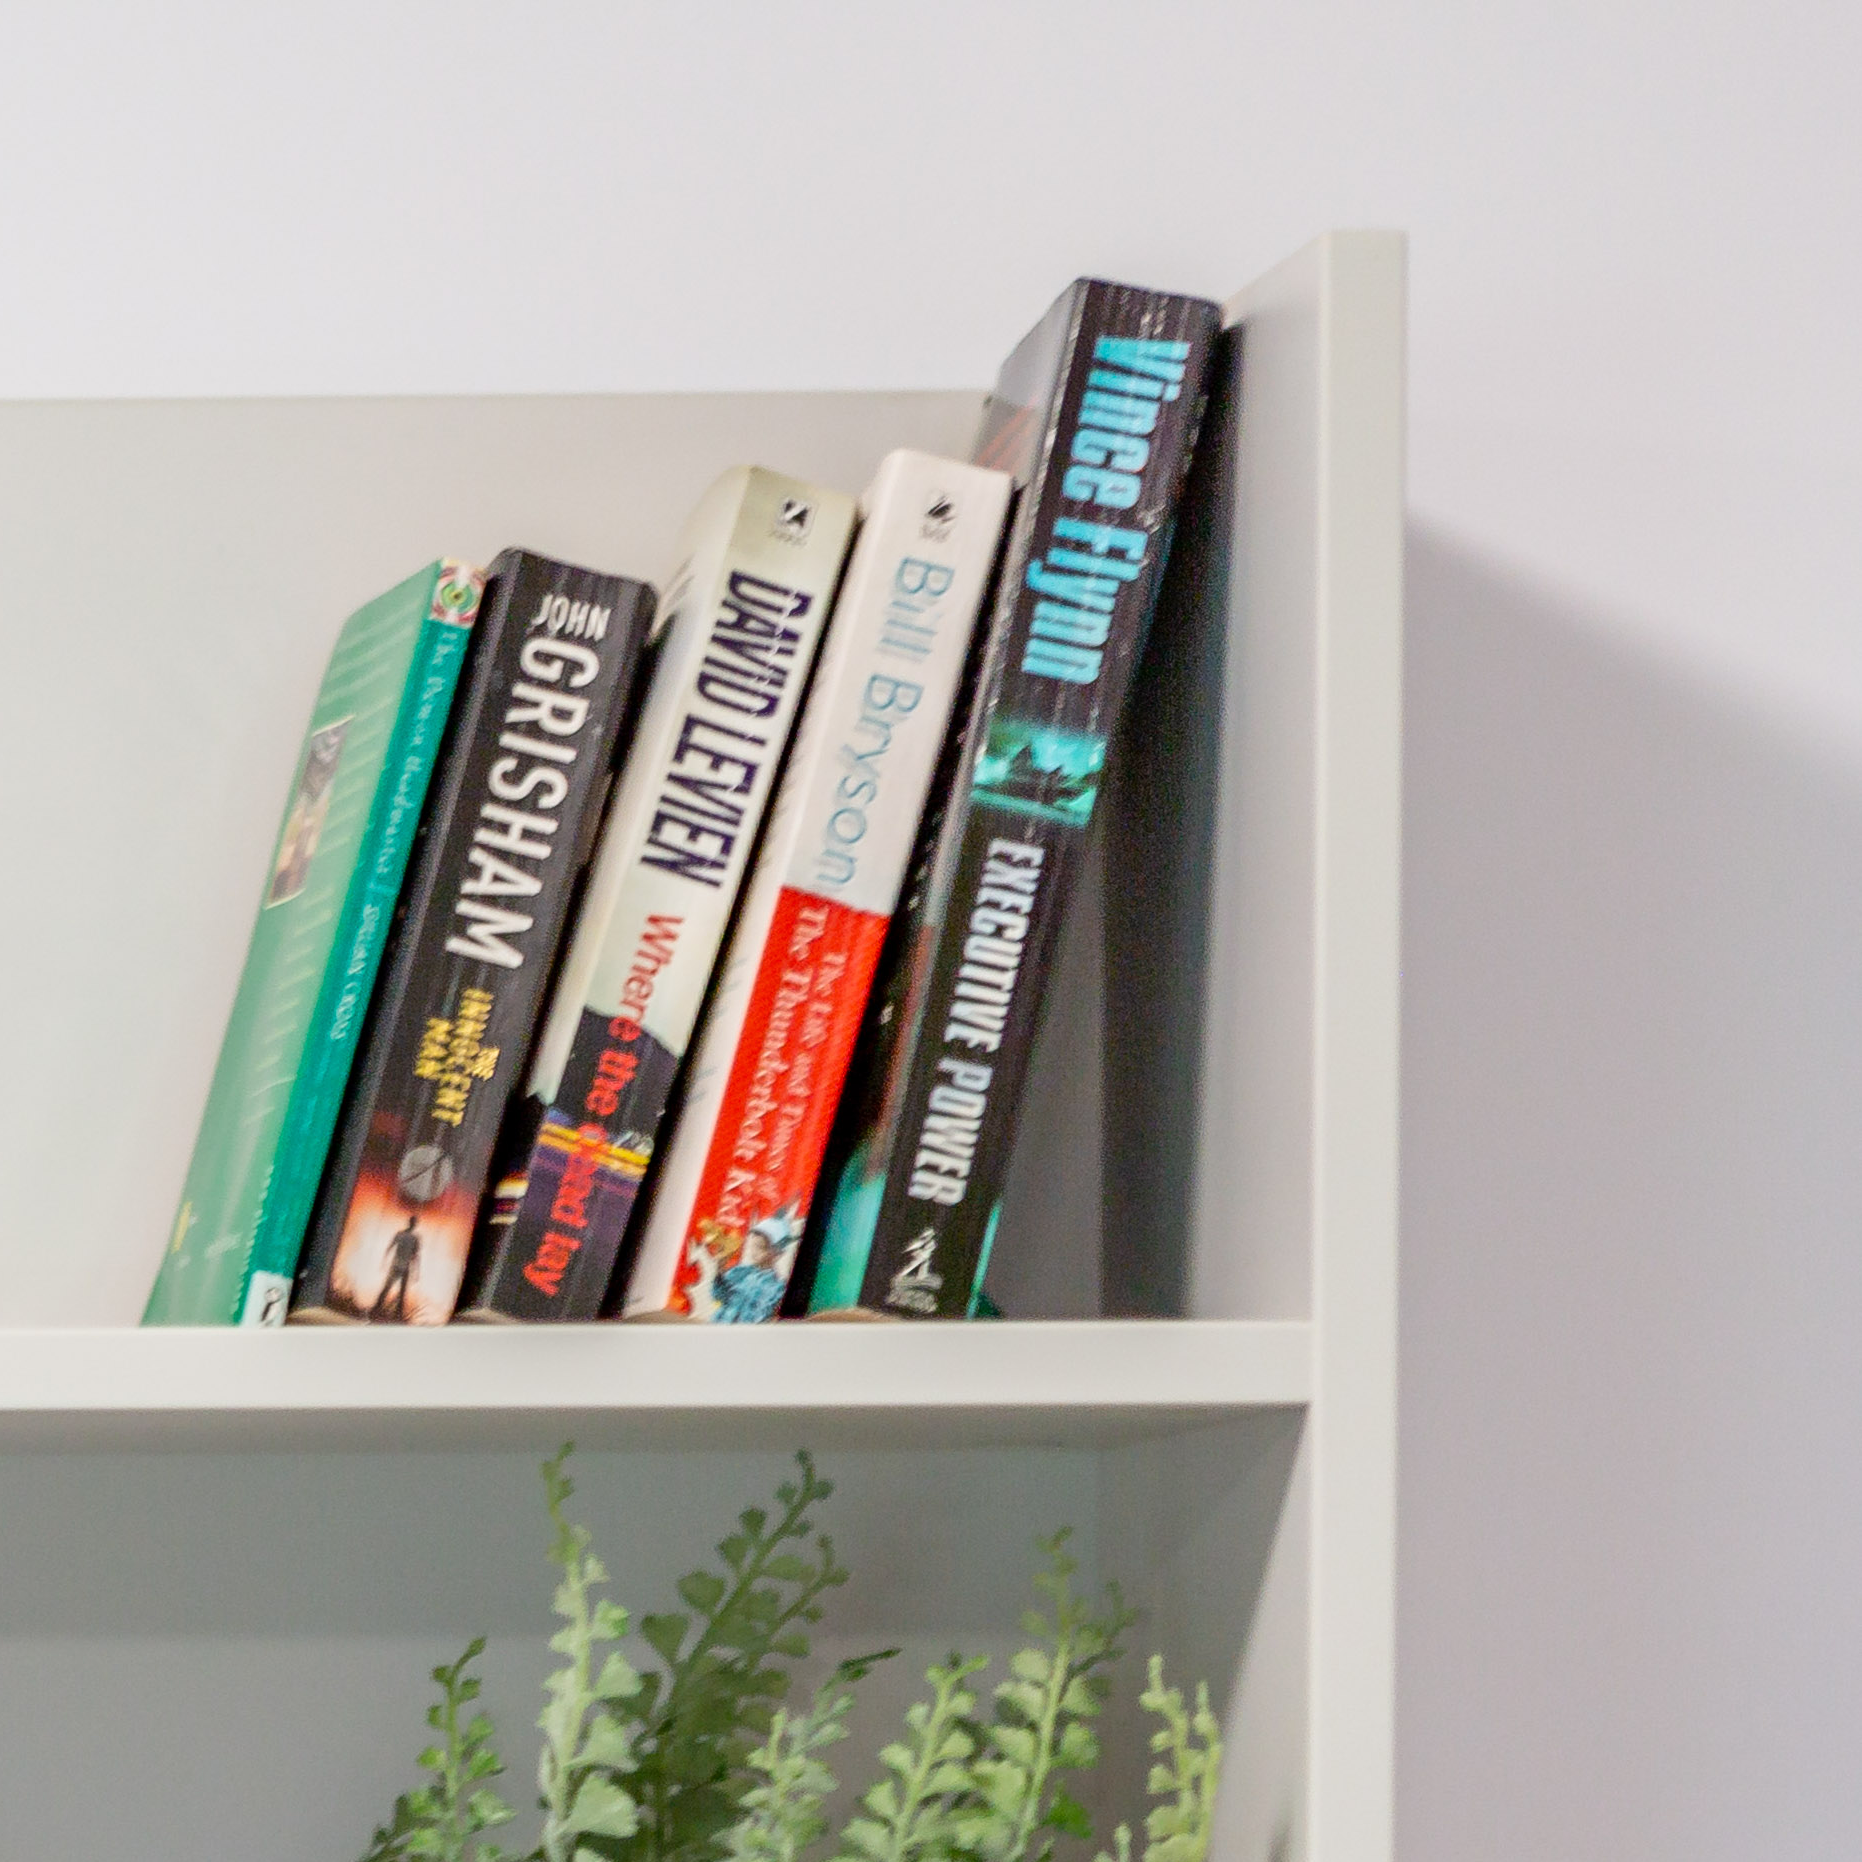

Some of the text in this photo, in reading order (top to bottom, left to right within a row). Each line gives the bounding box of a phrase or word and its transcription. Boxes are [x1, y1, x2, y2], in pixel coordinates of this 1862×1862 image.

[532, 593, 611, 641] JOHN
[1021, 335, 1192, 685] Vince Flynn
[446, 636, 600, 969] GRISHAM
[640, 569, 814, 889] DAVID LEVIEN
[816, 554, 955, 886] Bill Bryson
[609, 913, 685, 1043] Where
[716, 907, 829, 1228] The Thunderbolt Kid
[944, 838, 1045, 1053] EXECUTIVE
[585, 1050, 640, 1116] the
[908, 1056, 993, 1207] POWER
